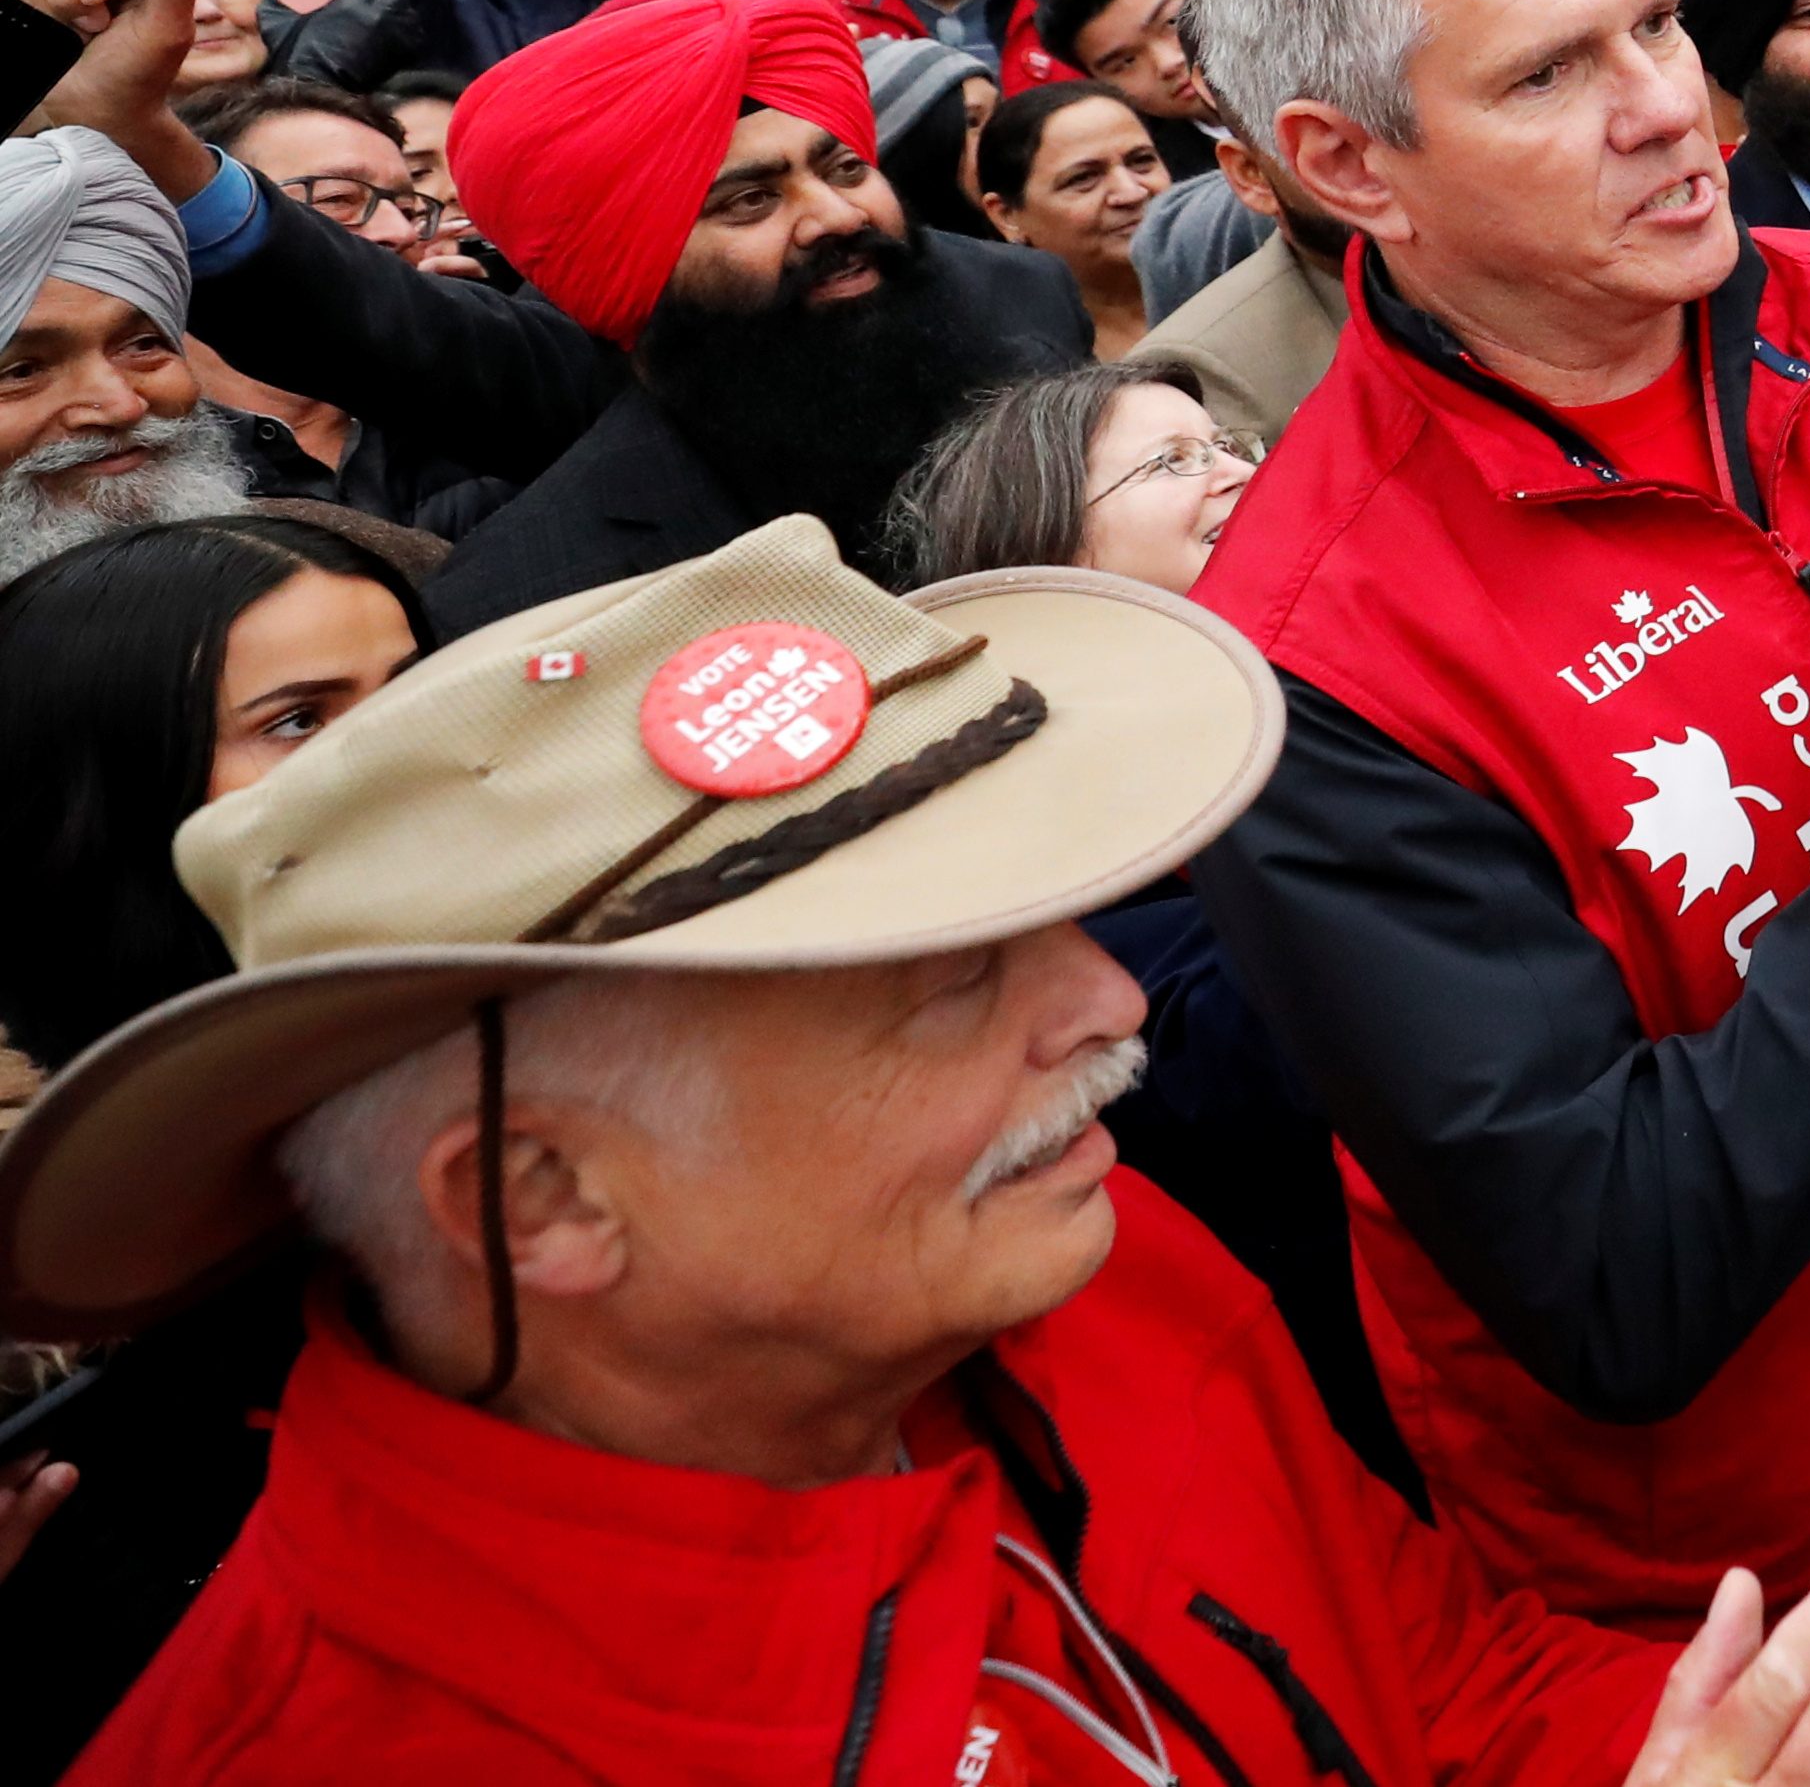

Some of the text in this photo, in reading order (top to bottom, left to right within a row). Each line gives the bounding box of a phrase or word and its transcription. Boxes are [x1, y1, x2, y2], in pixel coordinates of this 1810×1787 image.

[678, 643, 753, 697] VOTE
[1556, 584, 1725, 704] Liberal
[674, 671, 777, 744] Leon
[702, 659, 844, 774] JENSEN
